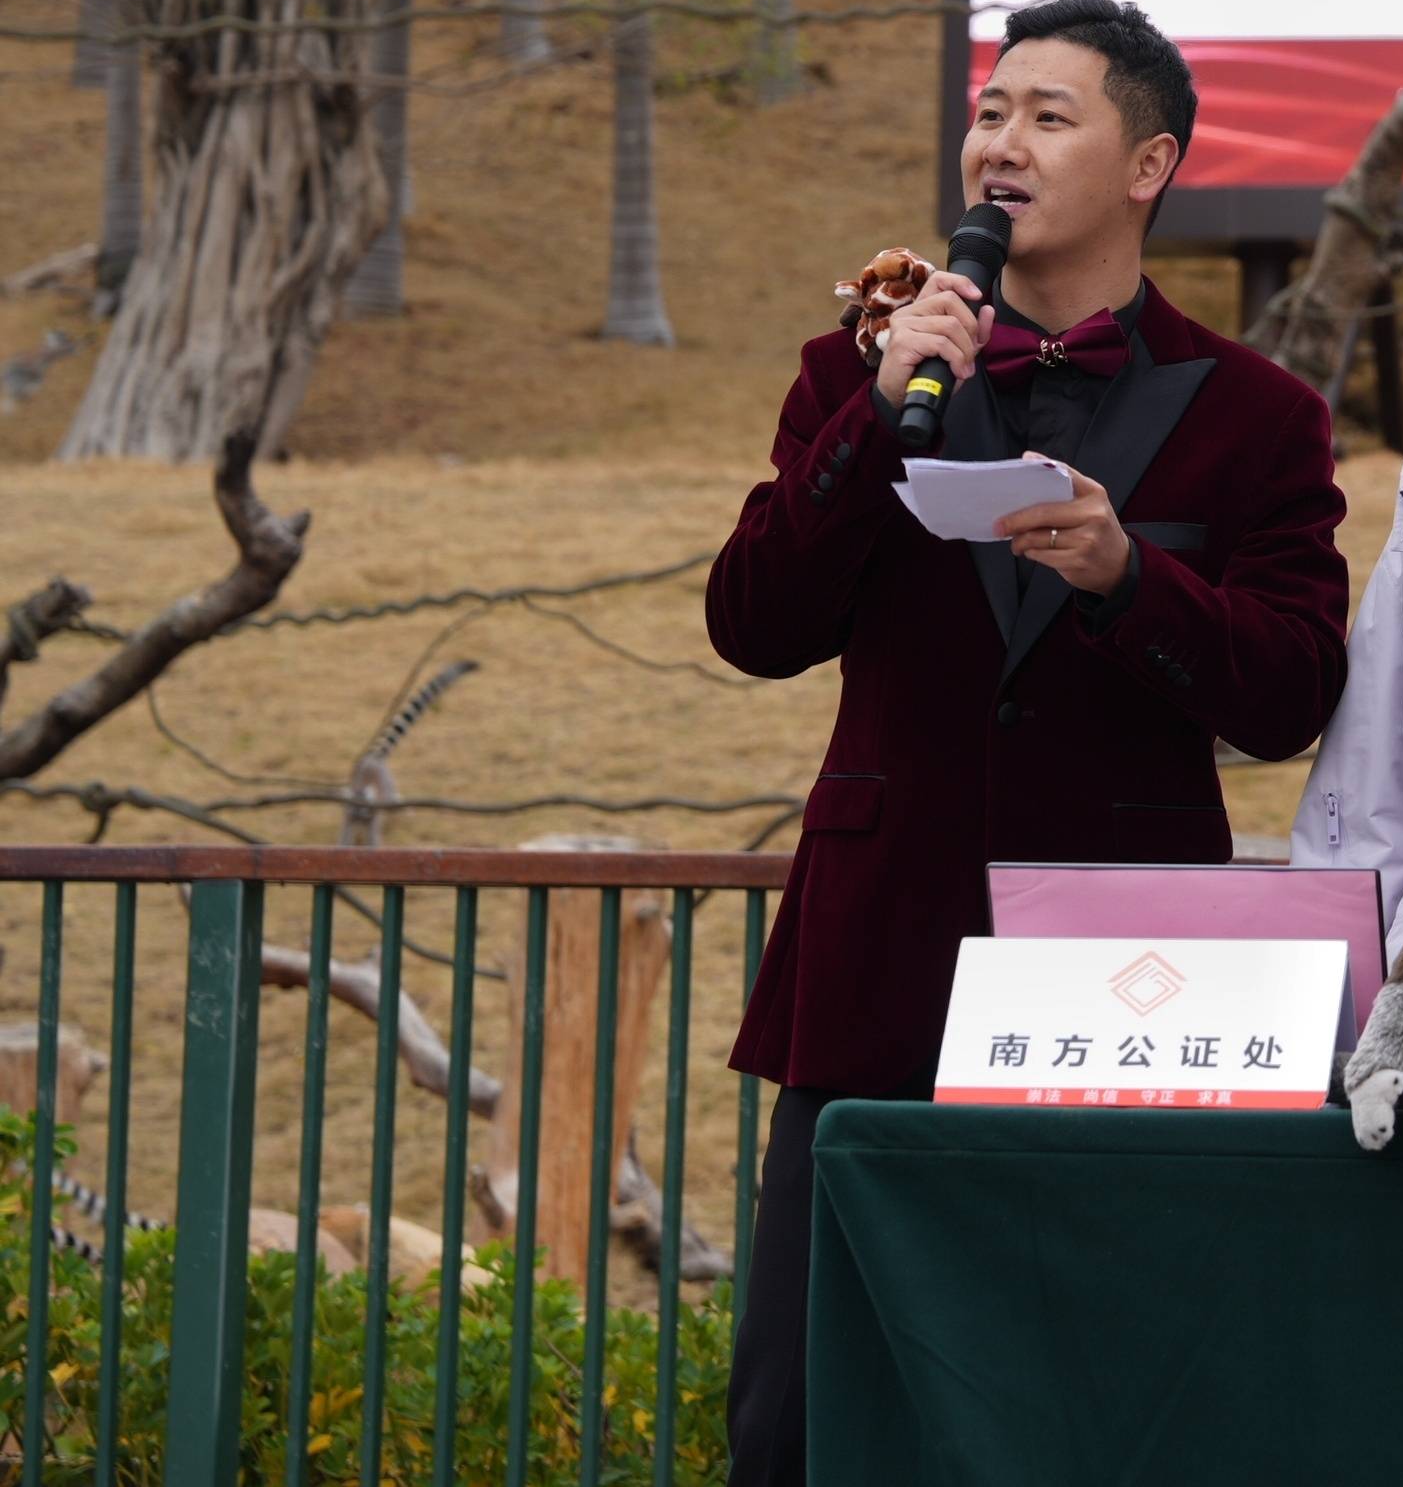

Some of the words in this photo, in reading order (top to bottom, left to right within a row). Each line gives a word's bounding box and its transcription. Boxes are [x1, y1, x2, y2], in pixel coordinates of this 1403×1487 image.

[988, 1033, 1284, 1070] 南方公证处
[1140, 1089, 1176, 1105] 守正
[1197, 1090, 1232, 1106] 求真
